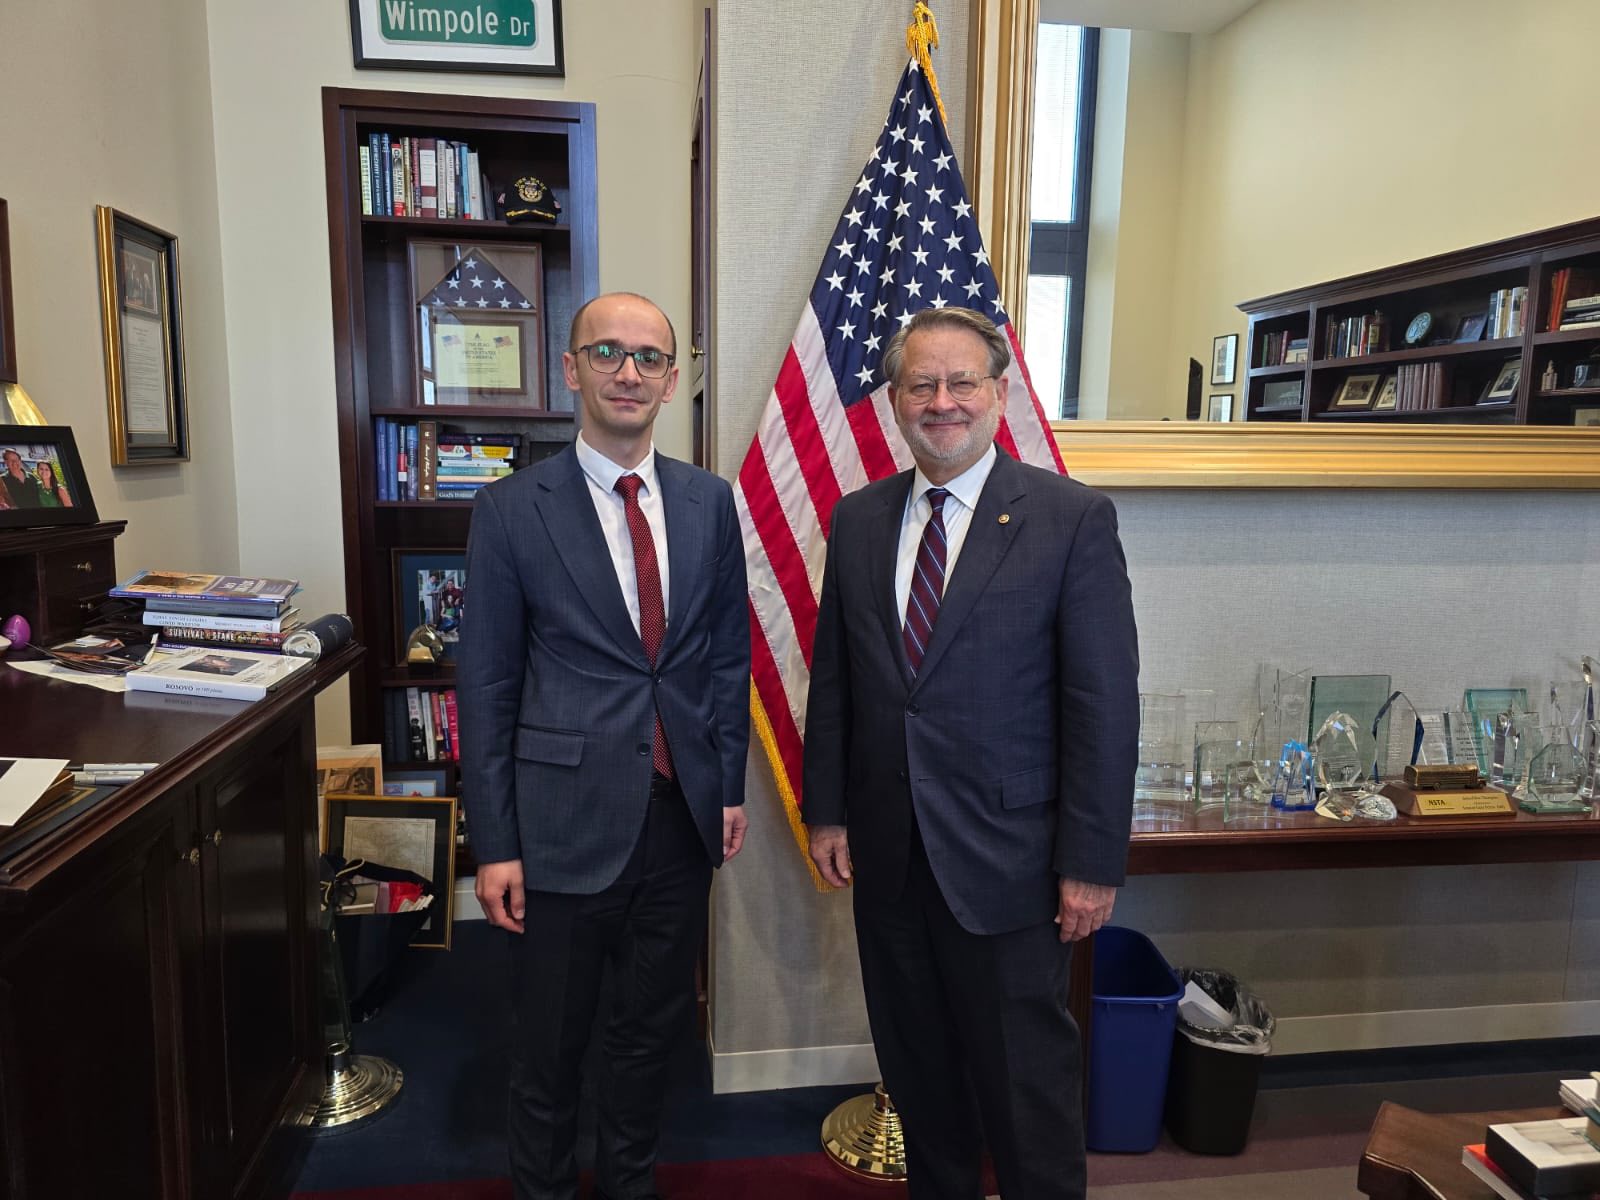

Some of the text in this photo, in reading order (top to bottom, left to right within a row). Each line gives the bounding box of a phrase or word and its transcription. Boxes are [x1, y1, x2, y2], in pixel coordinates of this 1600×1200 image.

[384, 0, 531, 40] Wimpole Dr
[168, 627, 205, 641] SURVIVAL
[165, 683, 194, 692] KOSOVO
